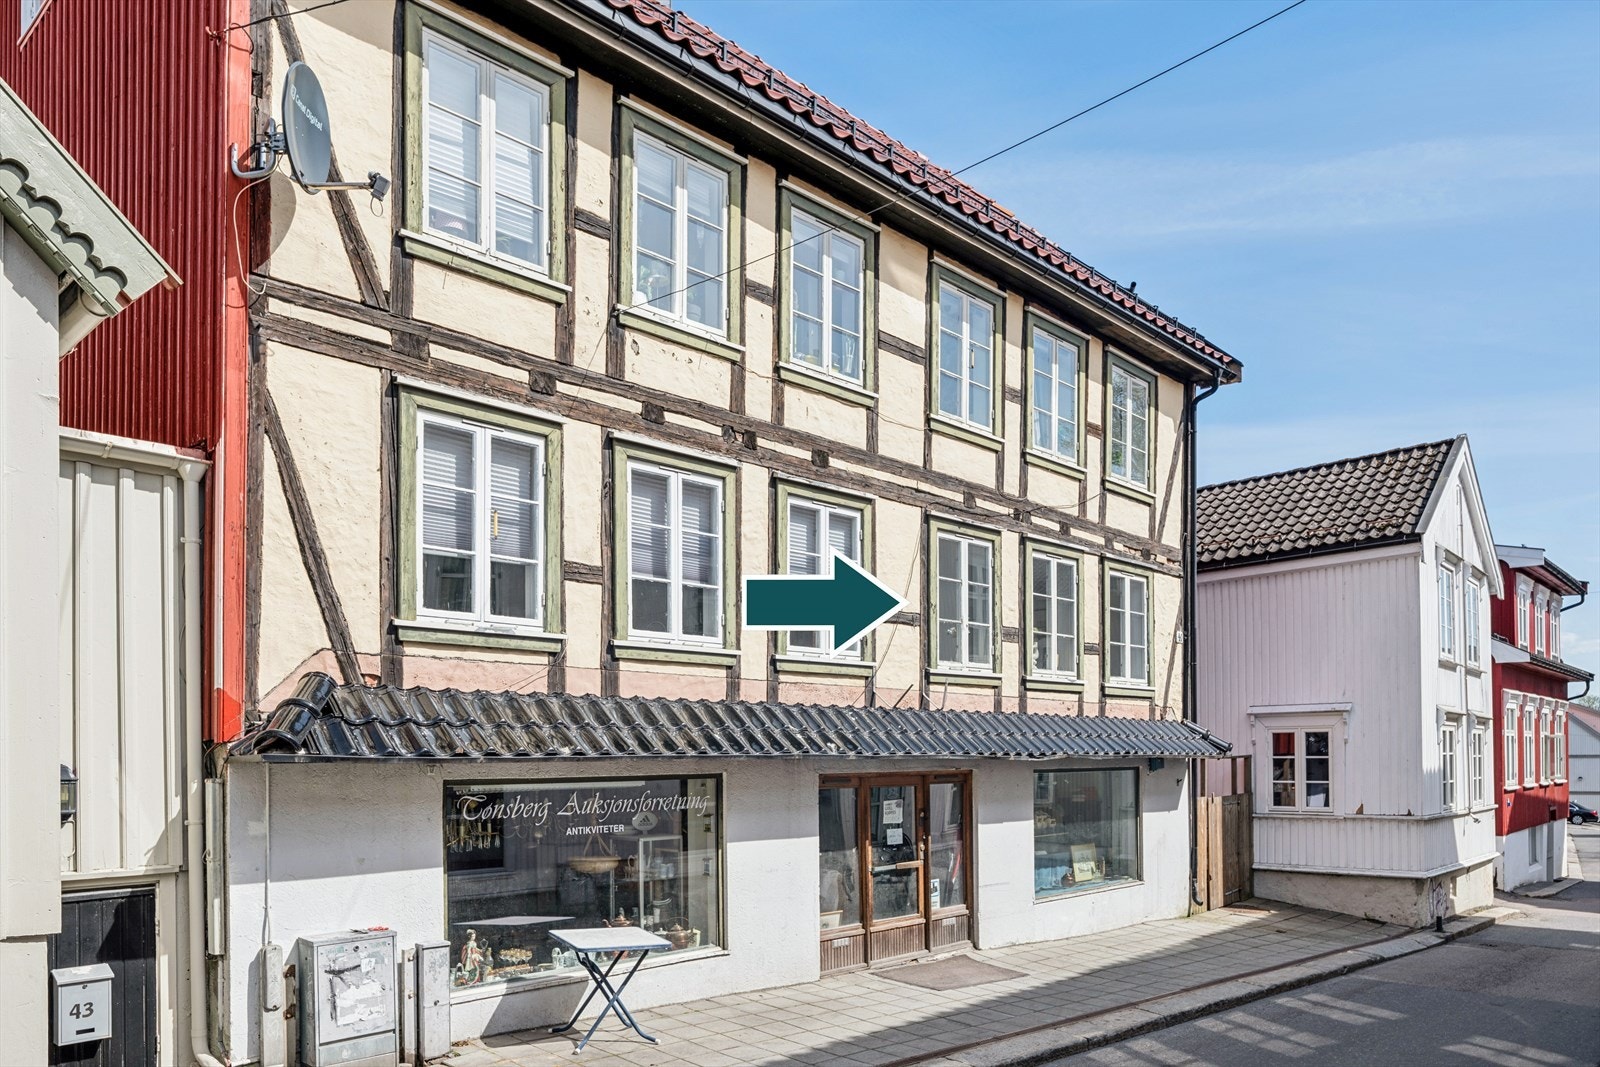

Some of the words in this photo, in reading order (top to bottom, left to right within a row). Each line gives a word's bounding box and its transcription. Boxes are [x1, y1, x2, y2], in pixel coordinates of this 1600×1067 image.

[295, 94, 307, 114] Canal
[305, 108, 323, 132] Digital
[456, 794, 552, 826] Tønsberg
[556, 790, 710, 822] Auksjonsforretning
[566, 824, 625, 836] ANTIKVITETER
[69, 1001, 94, 1020] 43
